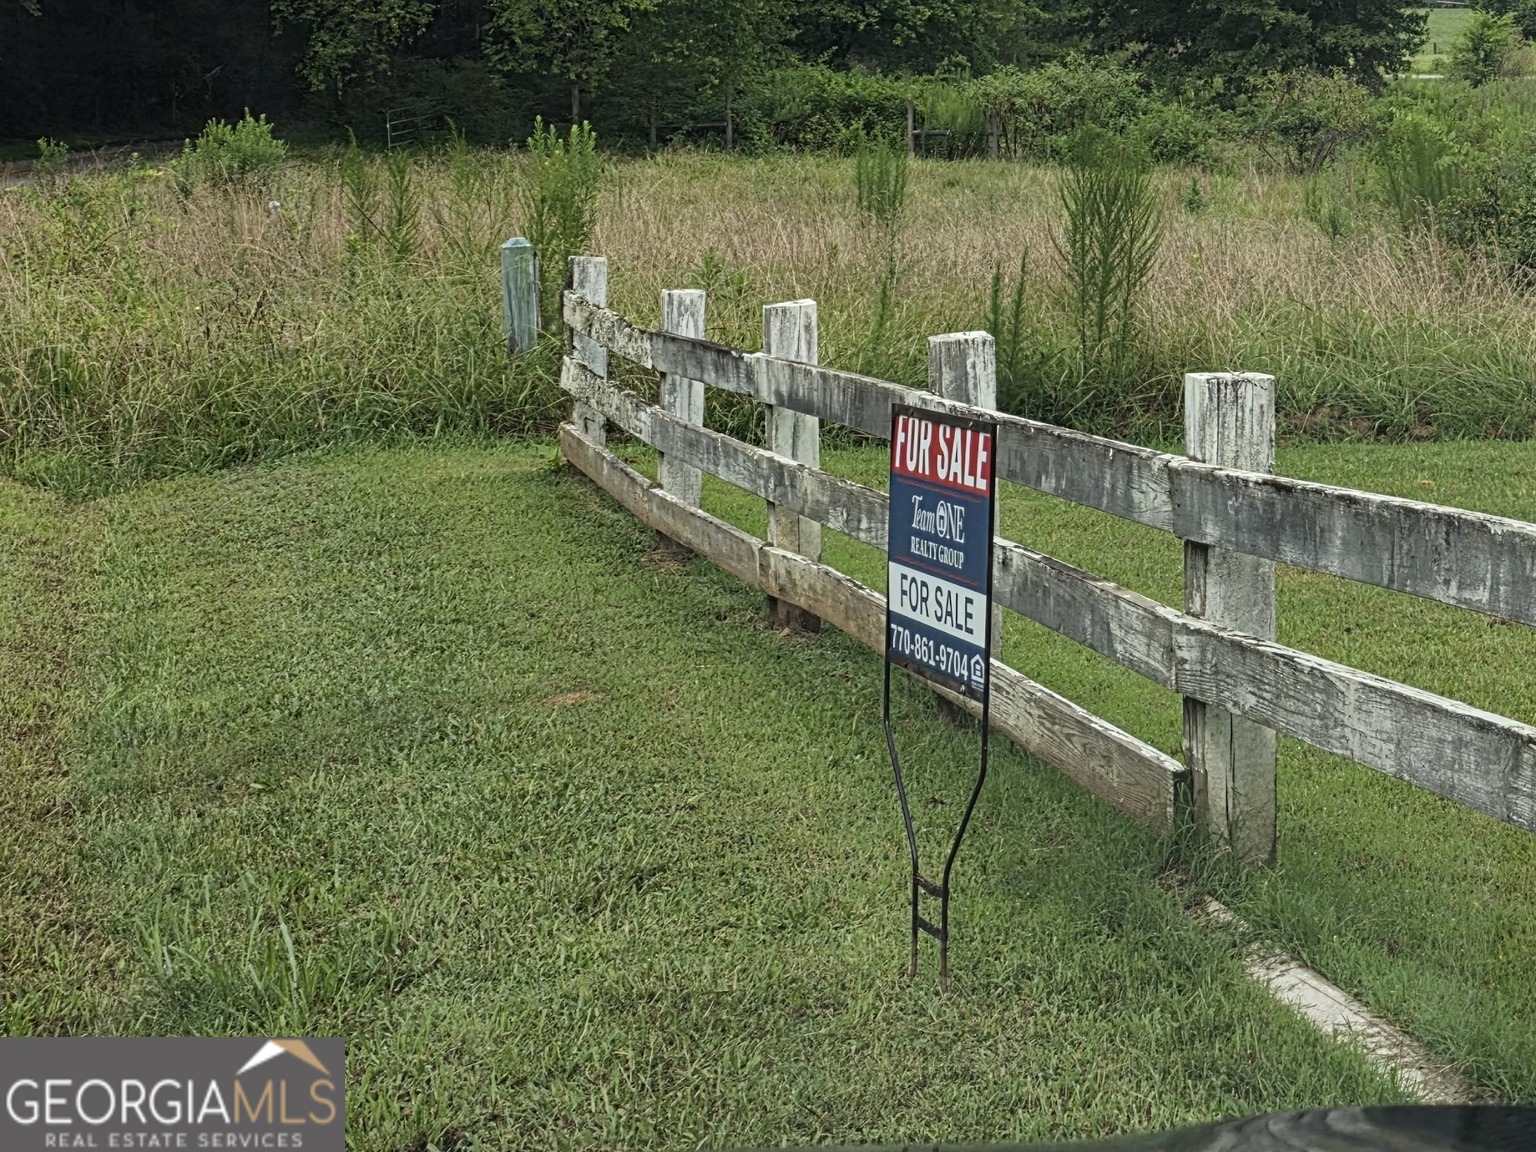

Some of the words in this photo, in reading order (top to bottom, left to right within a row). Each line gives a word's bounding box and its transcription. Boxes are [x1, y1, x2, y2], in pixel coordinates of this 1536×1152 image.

[895, 415, 933, 475] FOR
[936, 423, 991, 491] SALE
[910, 536, 938, 561] REALTY
[938, 545, 964, 569] GROUP
[900, 573, 930, 617] FOR
[934, 585, 974, 635] SALE
[890, 623, 969, 681] 770-861-9704
